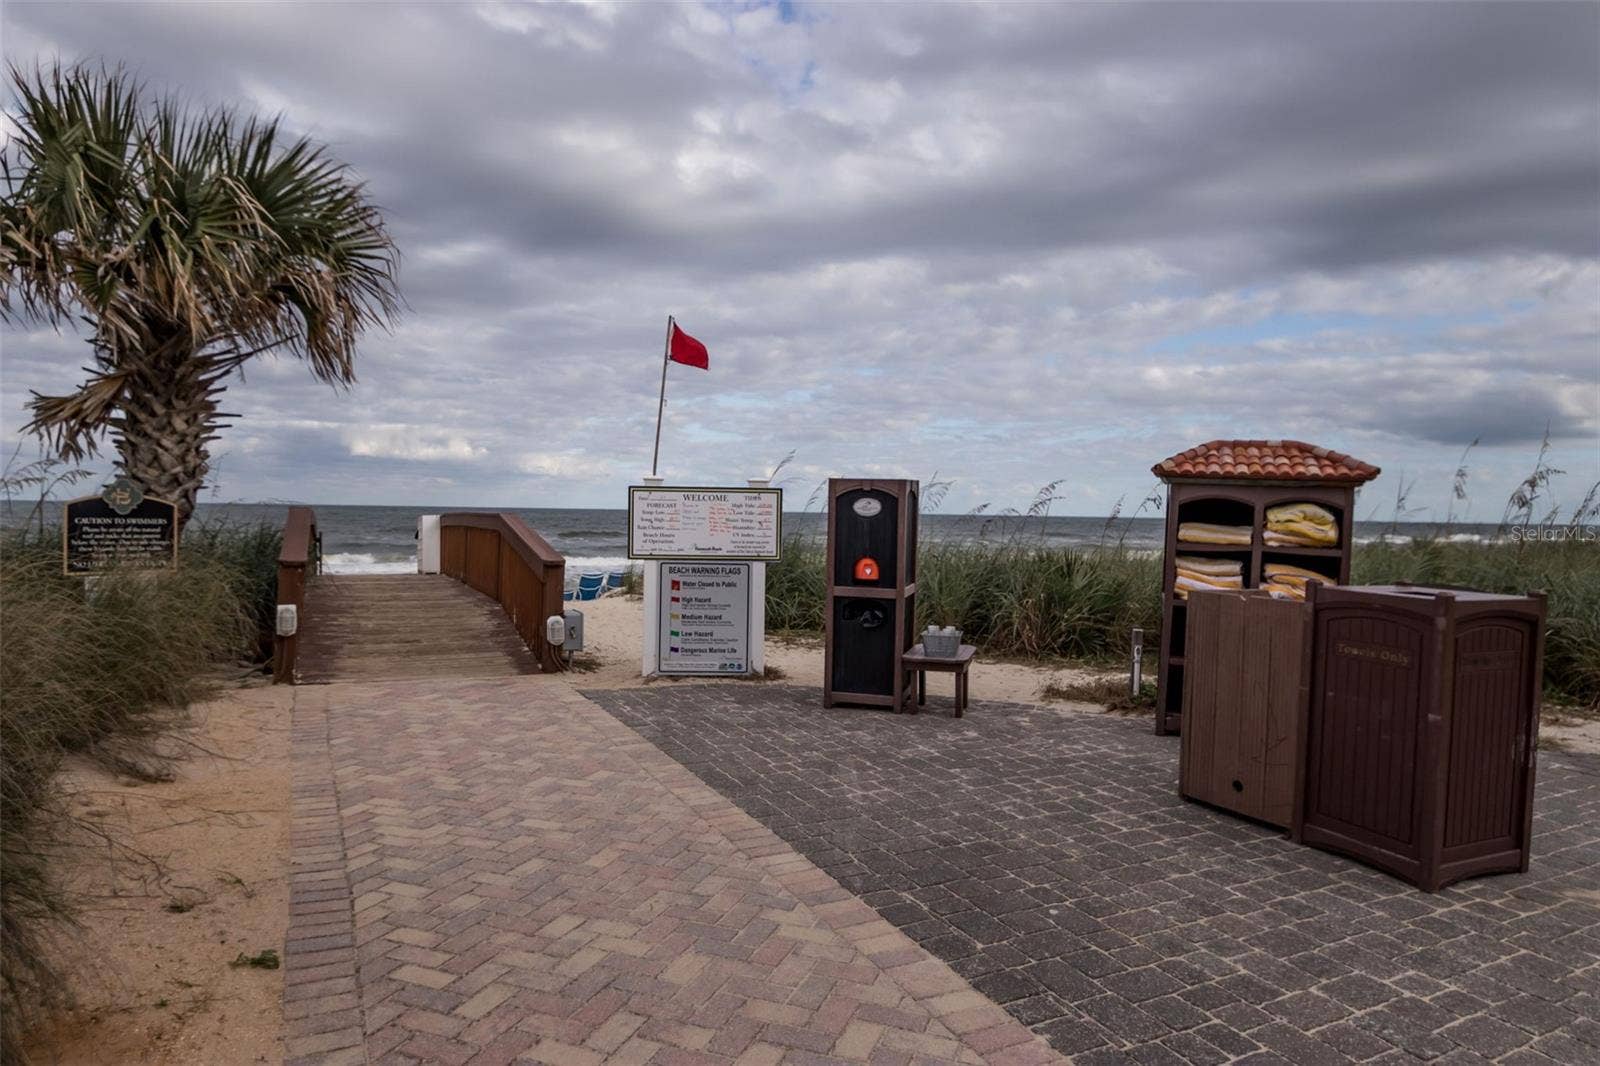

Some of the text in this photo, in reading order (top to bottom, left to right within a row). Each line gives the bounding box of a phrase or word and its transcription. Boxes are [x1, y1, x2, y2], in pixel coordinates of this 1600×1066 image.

[682, 494, 729, 502] WELCOME
[668, 566, 742, 576] BEACH WARNING FLAGS
[1380, 650, 1408, 666] Only
